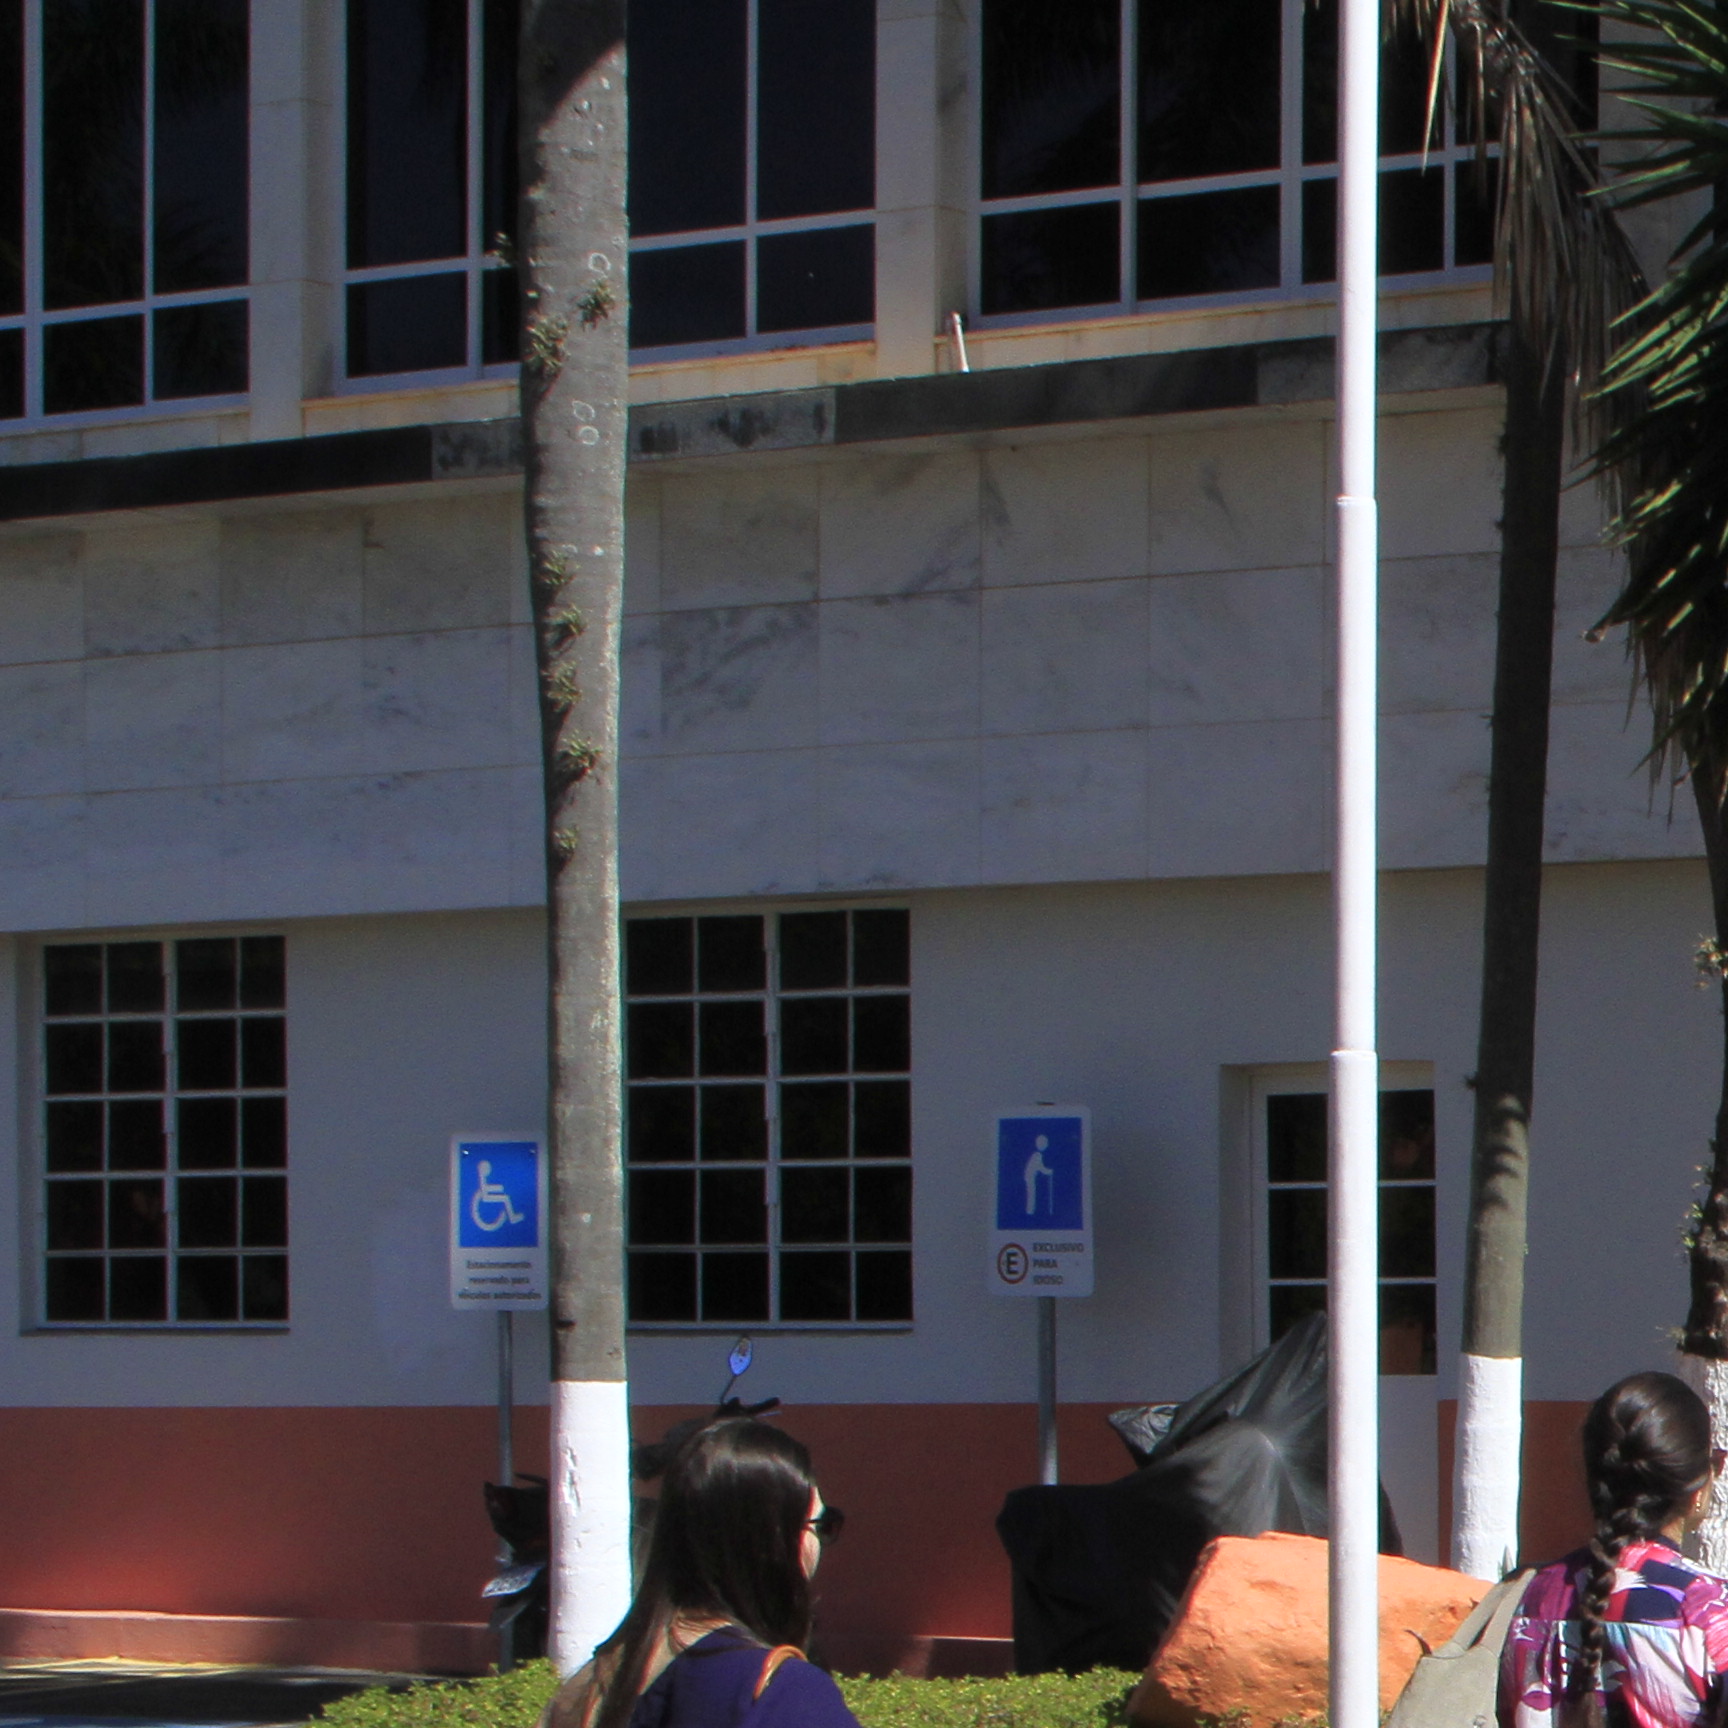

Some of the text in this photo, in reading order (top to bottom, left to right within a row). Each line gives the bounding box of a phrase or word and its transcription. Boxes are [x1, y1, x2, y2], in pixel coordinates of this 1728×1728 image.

[1032, 1242, 1084, 1253] EXCLUSIVO
[1006, 1251, 1020, 1275] E
[1032, 1258, 1058, 1268] PARA
